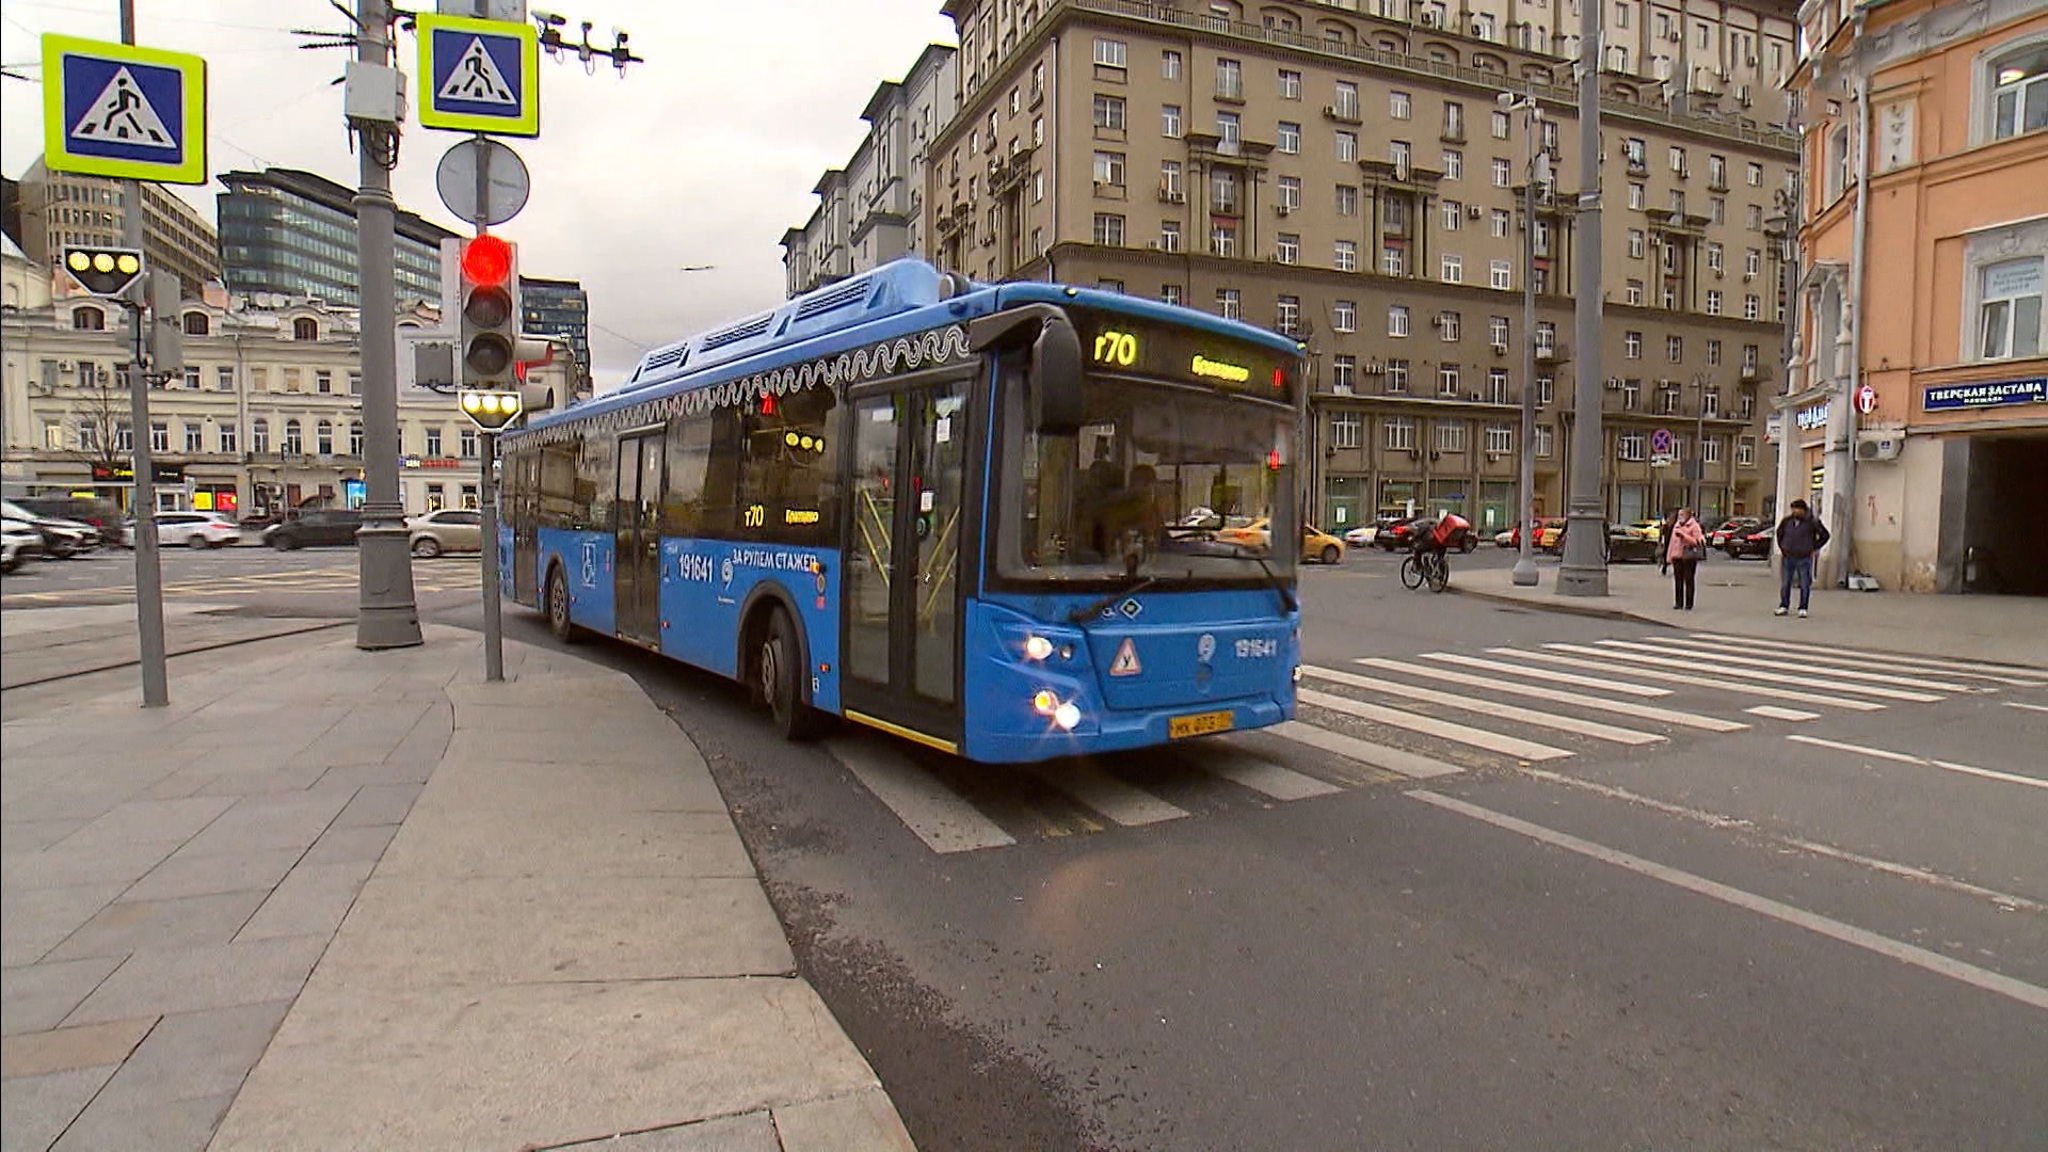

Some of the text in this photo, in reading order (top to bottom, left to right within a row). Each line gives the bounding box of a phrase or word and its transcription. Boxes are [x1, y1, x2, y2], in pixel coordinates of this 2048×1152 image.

[1929, 383, 2042, 401] ТВЕРСКАЯ ЗАСТАВА
[744, 505, 764, 526] т70
[679, 553, 713, 583] 191641
[732, 548, 743, 564] ЗА
[744, 549, 775, 570] РУЛЕМ
[1234, 639, 1278, 658] 191641
